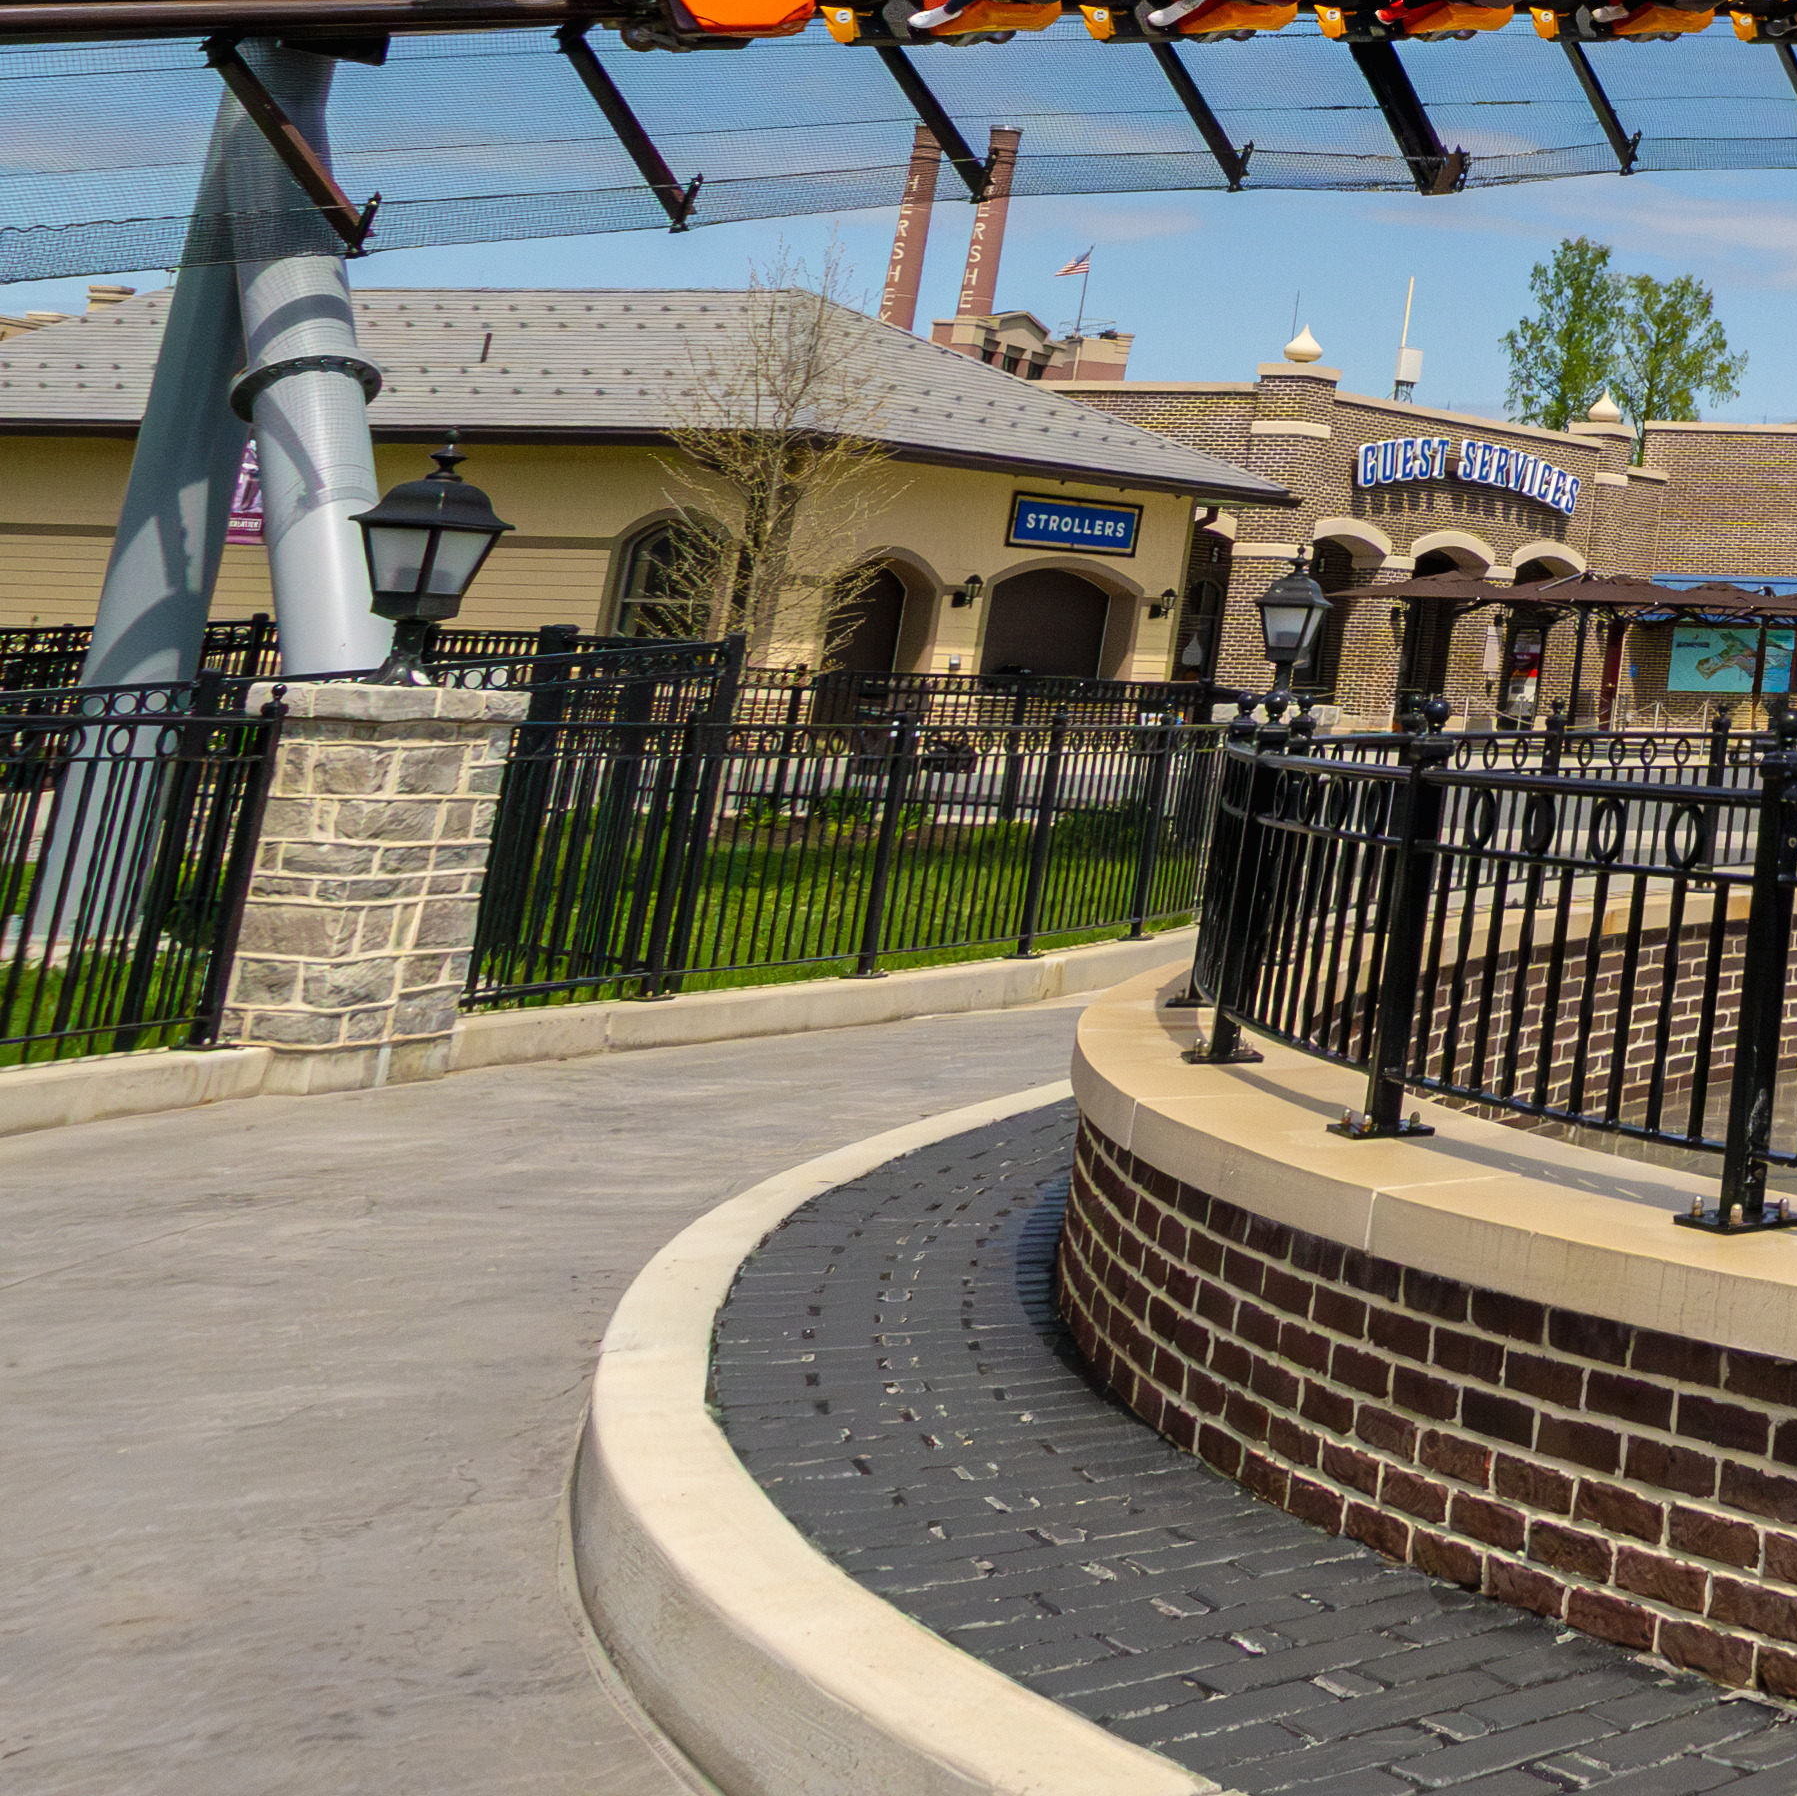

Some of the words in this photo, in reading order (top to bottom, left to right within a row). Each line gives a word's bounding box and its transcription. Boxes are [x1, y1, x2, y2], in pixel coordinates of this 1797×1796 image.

[959, 177, 998, 308] ERSHE
[1358, 437, 1451, 488] GUEST
[1458, 439, 1581, 516] SERVICES
[1026, 513, 1126, 537] STROLLERS
